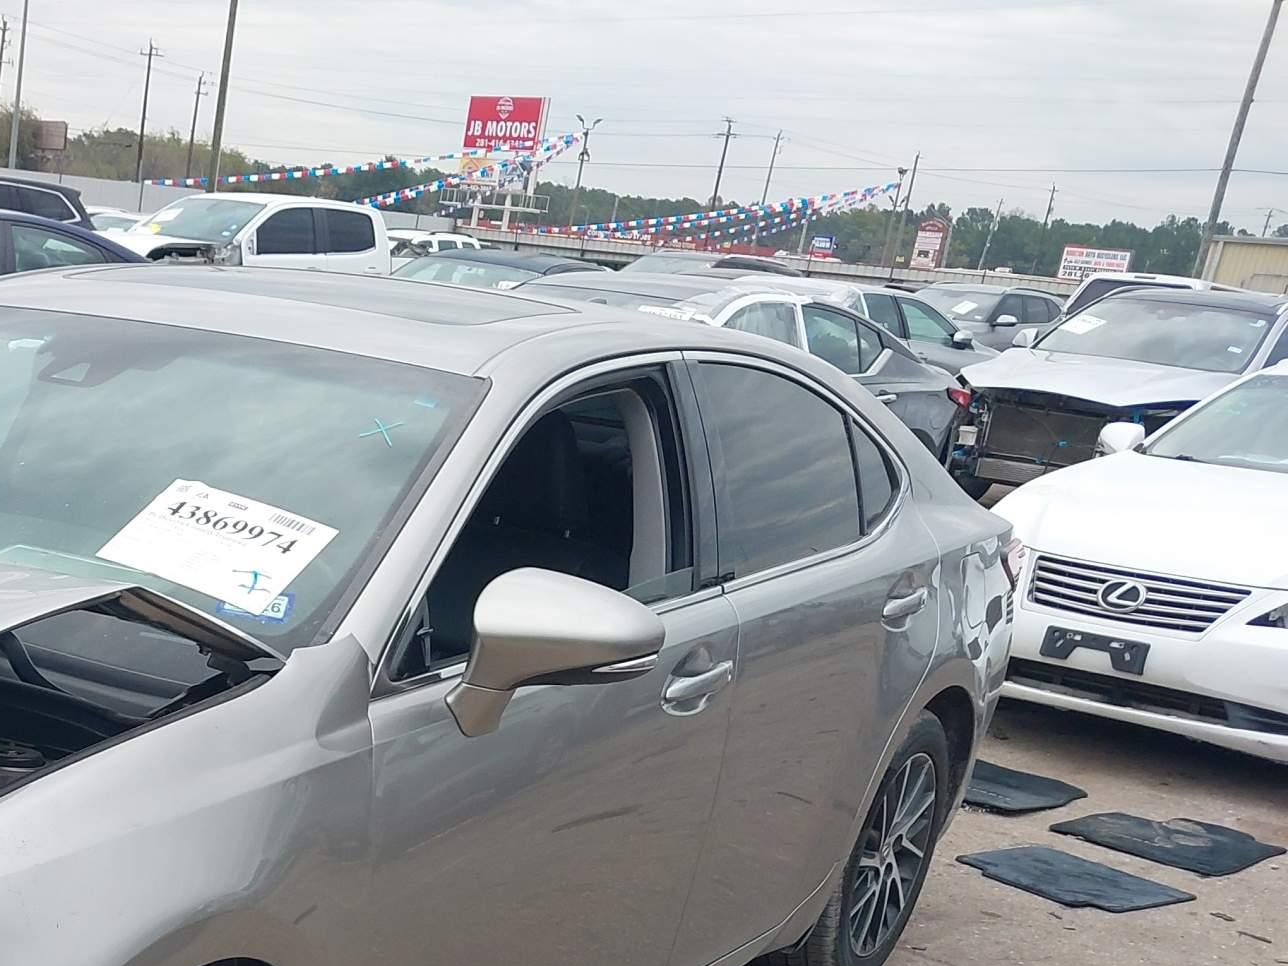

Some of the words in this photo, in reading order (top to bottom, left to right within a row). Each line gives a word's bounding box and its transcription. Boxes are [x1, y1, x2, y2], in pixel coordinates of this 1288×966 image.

[468, 120, 483, 136] JB
[486, 121, 536, 138] MOTORS
[168, 501, 298, 554] 43869974
